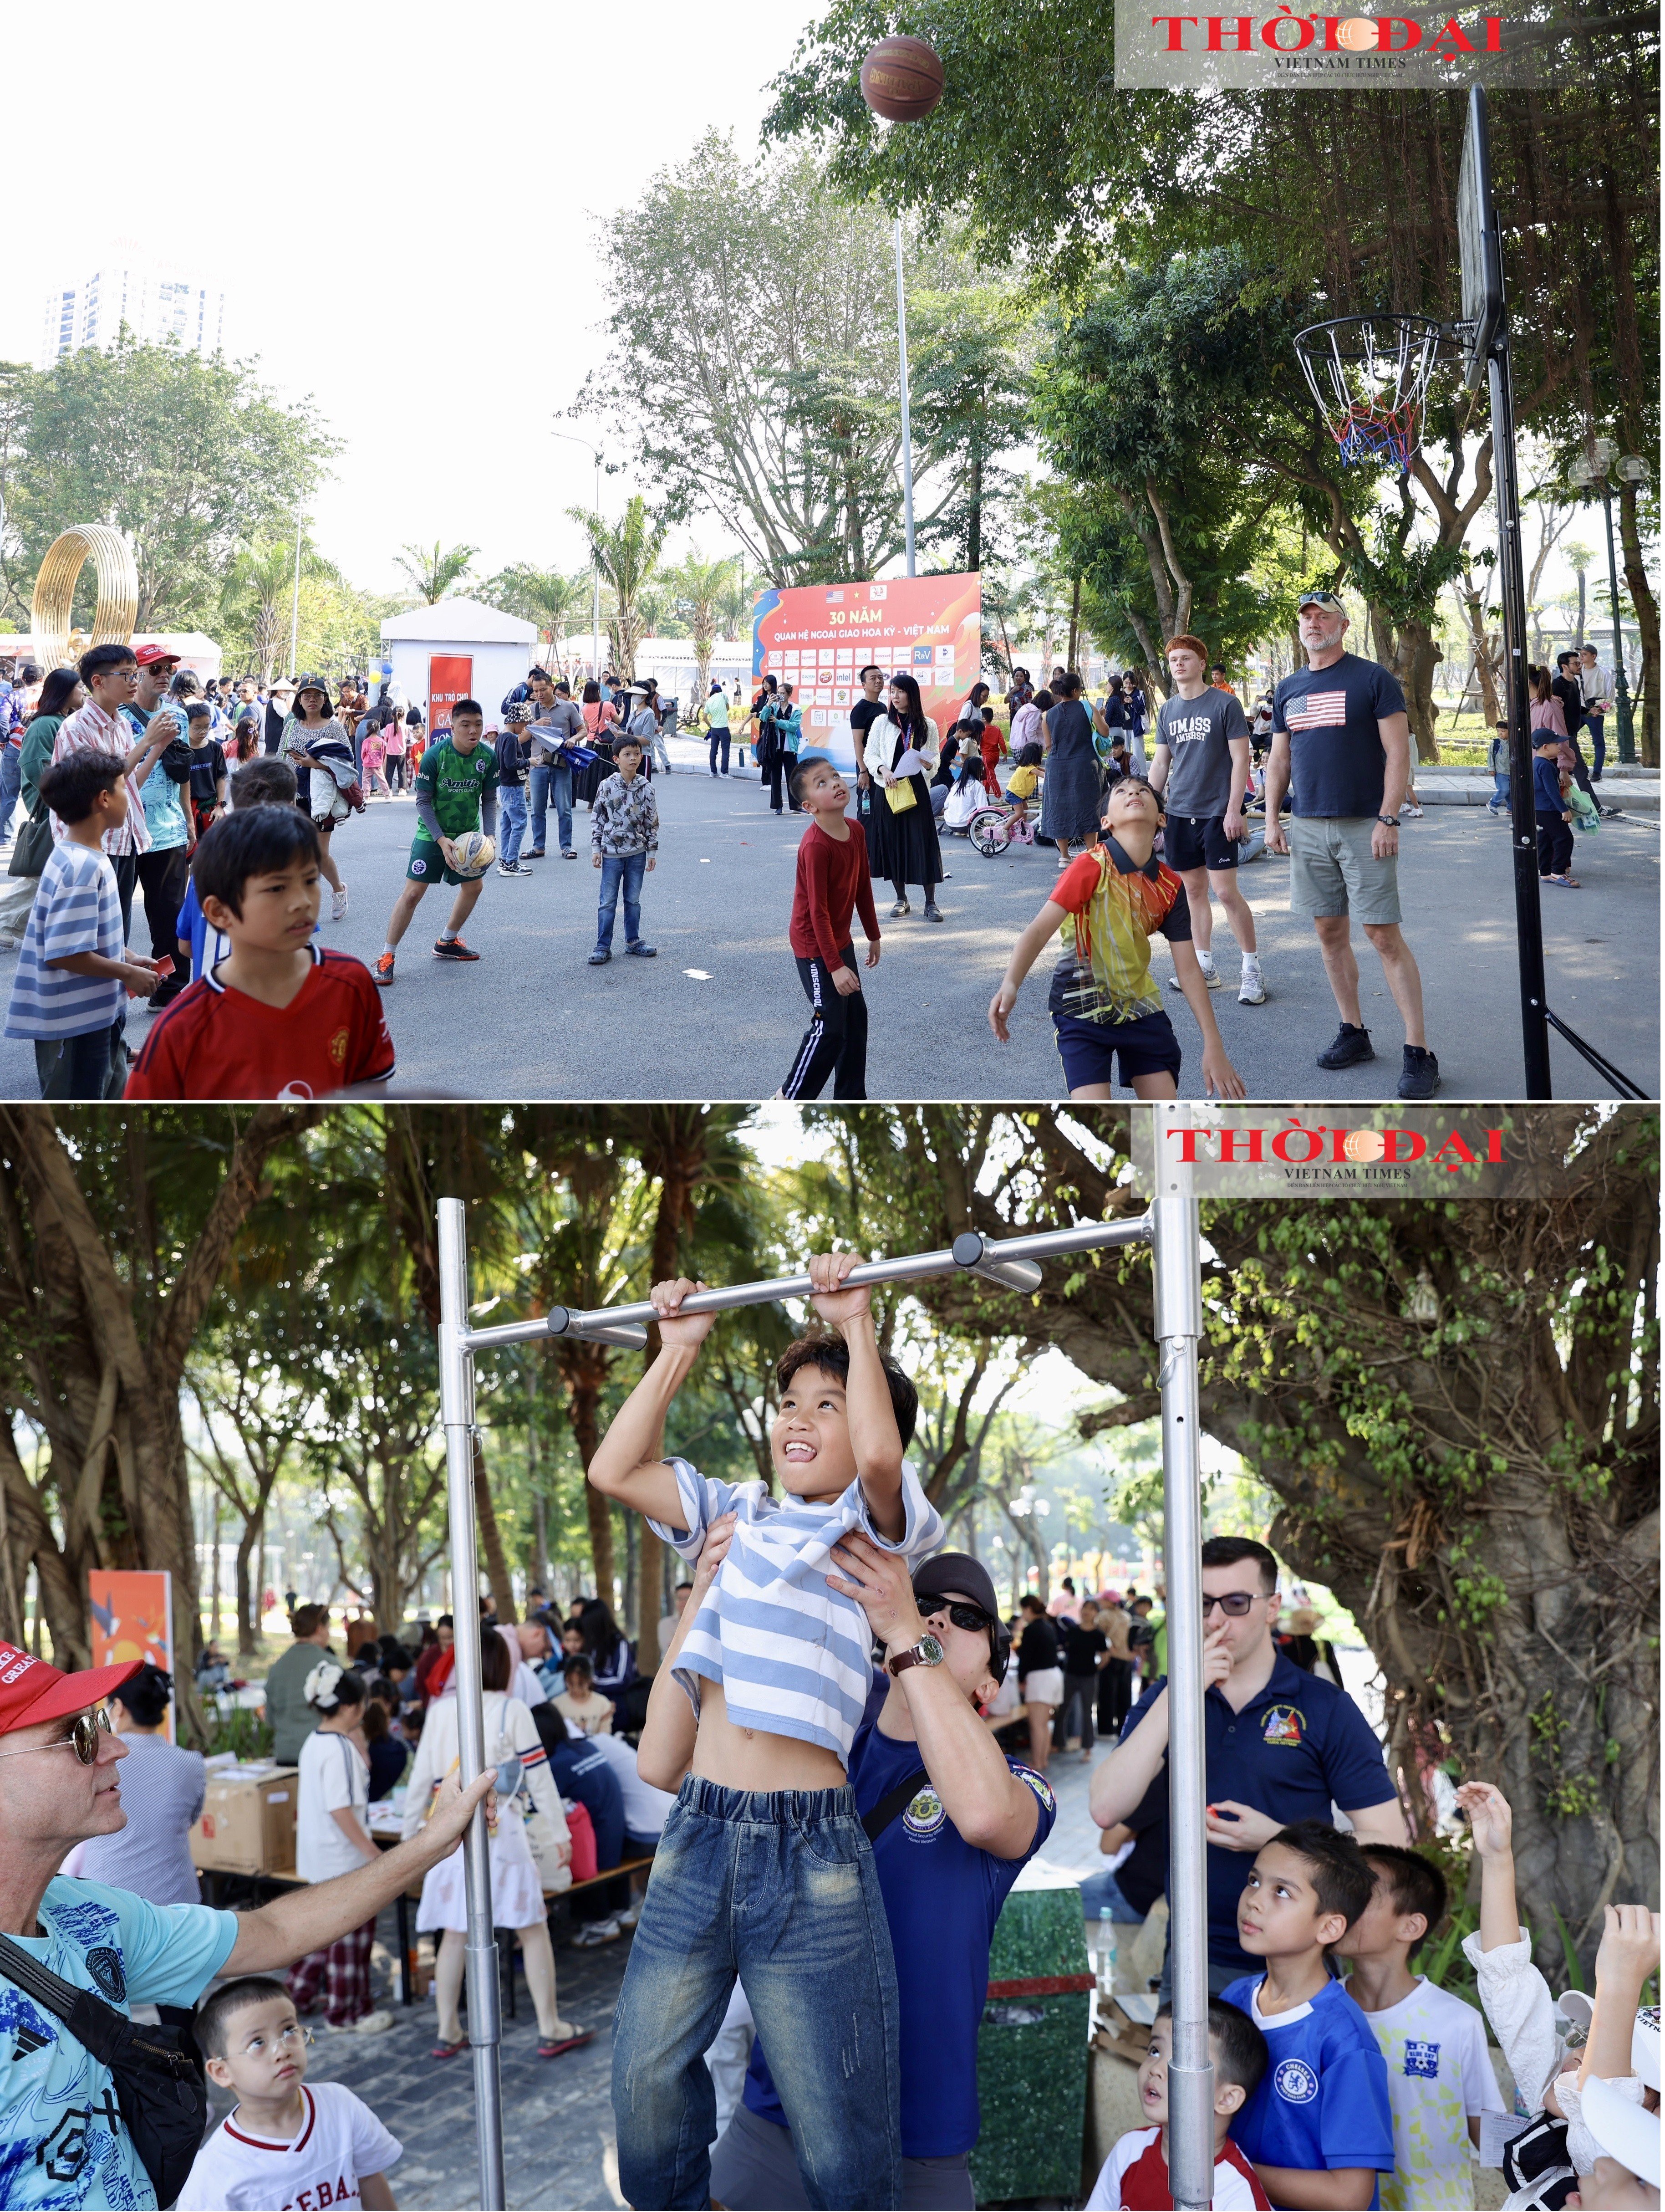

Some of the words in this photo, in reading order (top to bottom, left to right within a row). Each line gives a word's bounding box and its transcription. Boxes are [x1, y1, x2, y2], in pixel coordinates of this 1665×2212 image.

[829, 611, 845, 625] 30
[850, 606, 882, 624] NĂM
[774, 632, 796, 643] QUAN
[798, 629, 809, 642] HỆ
[811, 630, 836, 640] NGOẠI
[839, 628, 860, 638] GIAO
[862, 628, 881, 637] HOA
[884, 625, 896, 636] KỲ
[903, 624, 924, 637] VIỆT
[927, 624, 949, 634] NAM
[914, 650, 931, 660] R&V
[432, 693, 443, 702] KHU
[444, 690, 455, 702] TRÒ
[457, 692, 468, 701] CHƠI
[438, 713, 453, 728] GA
[1169, 717, 1211, 736] UMASS
[1176, 731, 1206, 744] AMHRST
[439, 777, 480, 788] Amitie
[810, 963, 822, 1007] VINSCHOOL
[2, 1655, 37, 1684] GREAT
[902, 1825, 917, 1837] Regional
[933, 1825, 944, 1835] Office
[95, 1959, 109, 1972] MIAMI
[1637, 2015, 1661, 2033] VIETN
[1286, 2063, 1311, 2080] CHELSEA
[281, 2175, 360, 2211] EBA
